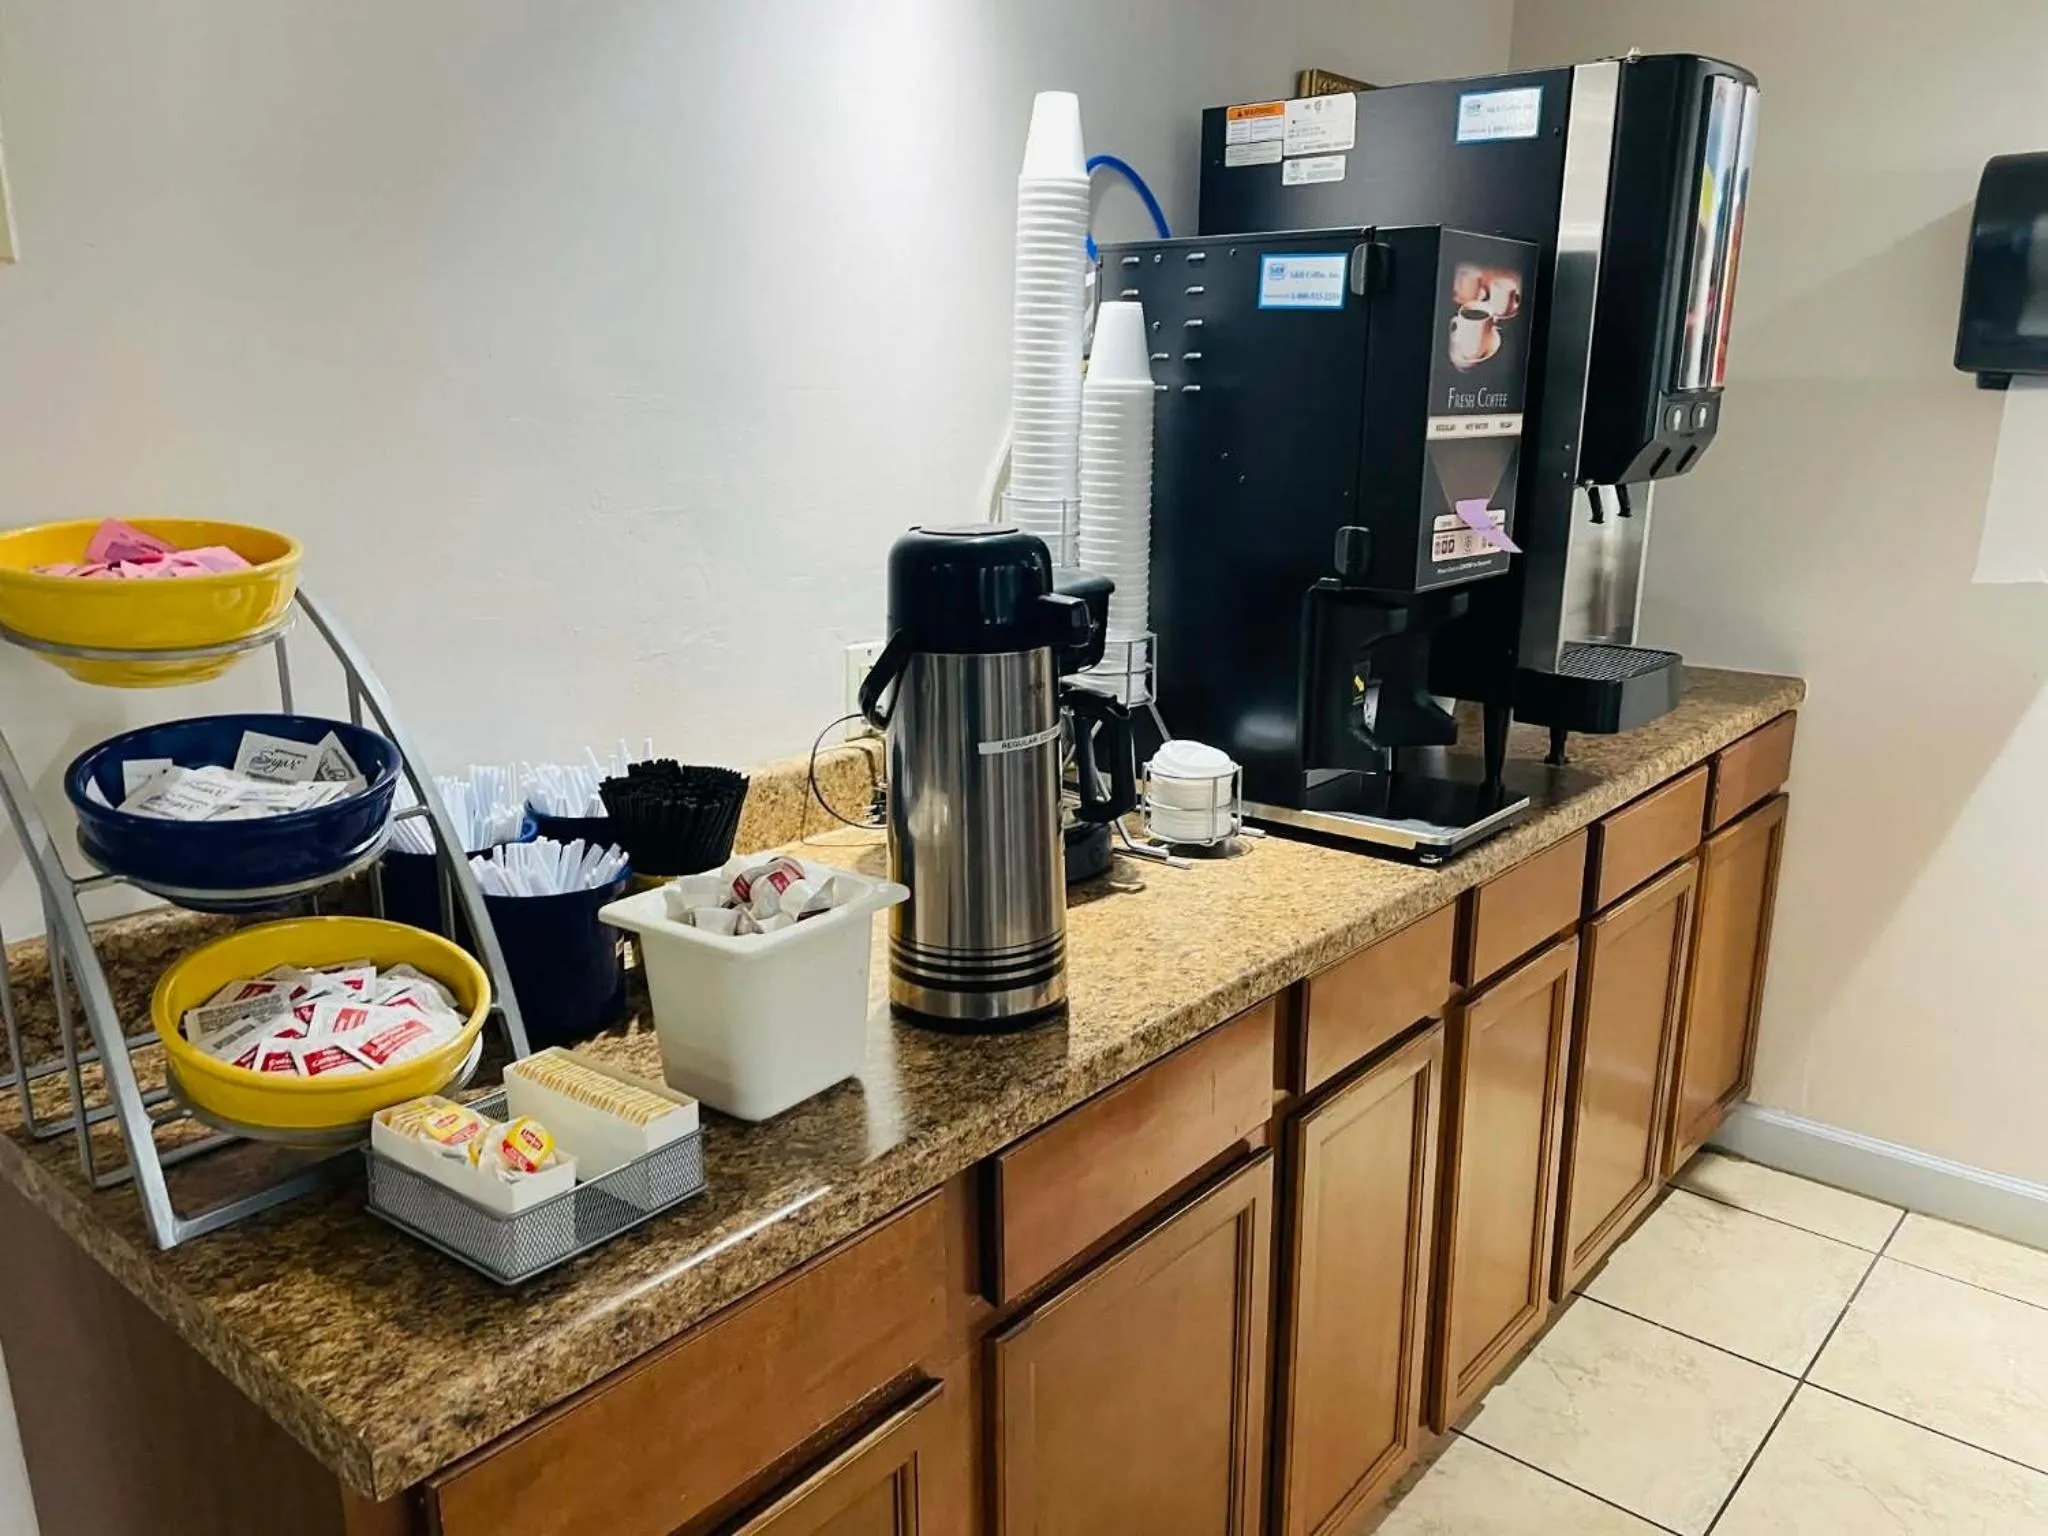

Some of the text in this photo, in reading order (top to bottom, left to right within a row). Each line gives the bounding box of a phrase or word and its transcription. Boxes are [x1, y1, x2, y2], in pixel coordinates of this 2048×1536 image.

[1448, 387, 1508, 409] FRESH COFFEE
[1001, 738, 1037, 749] REGULAR
